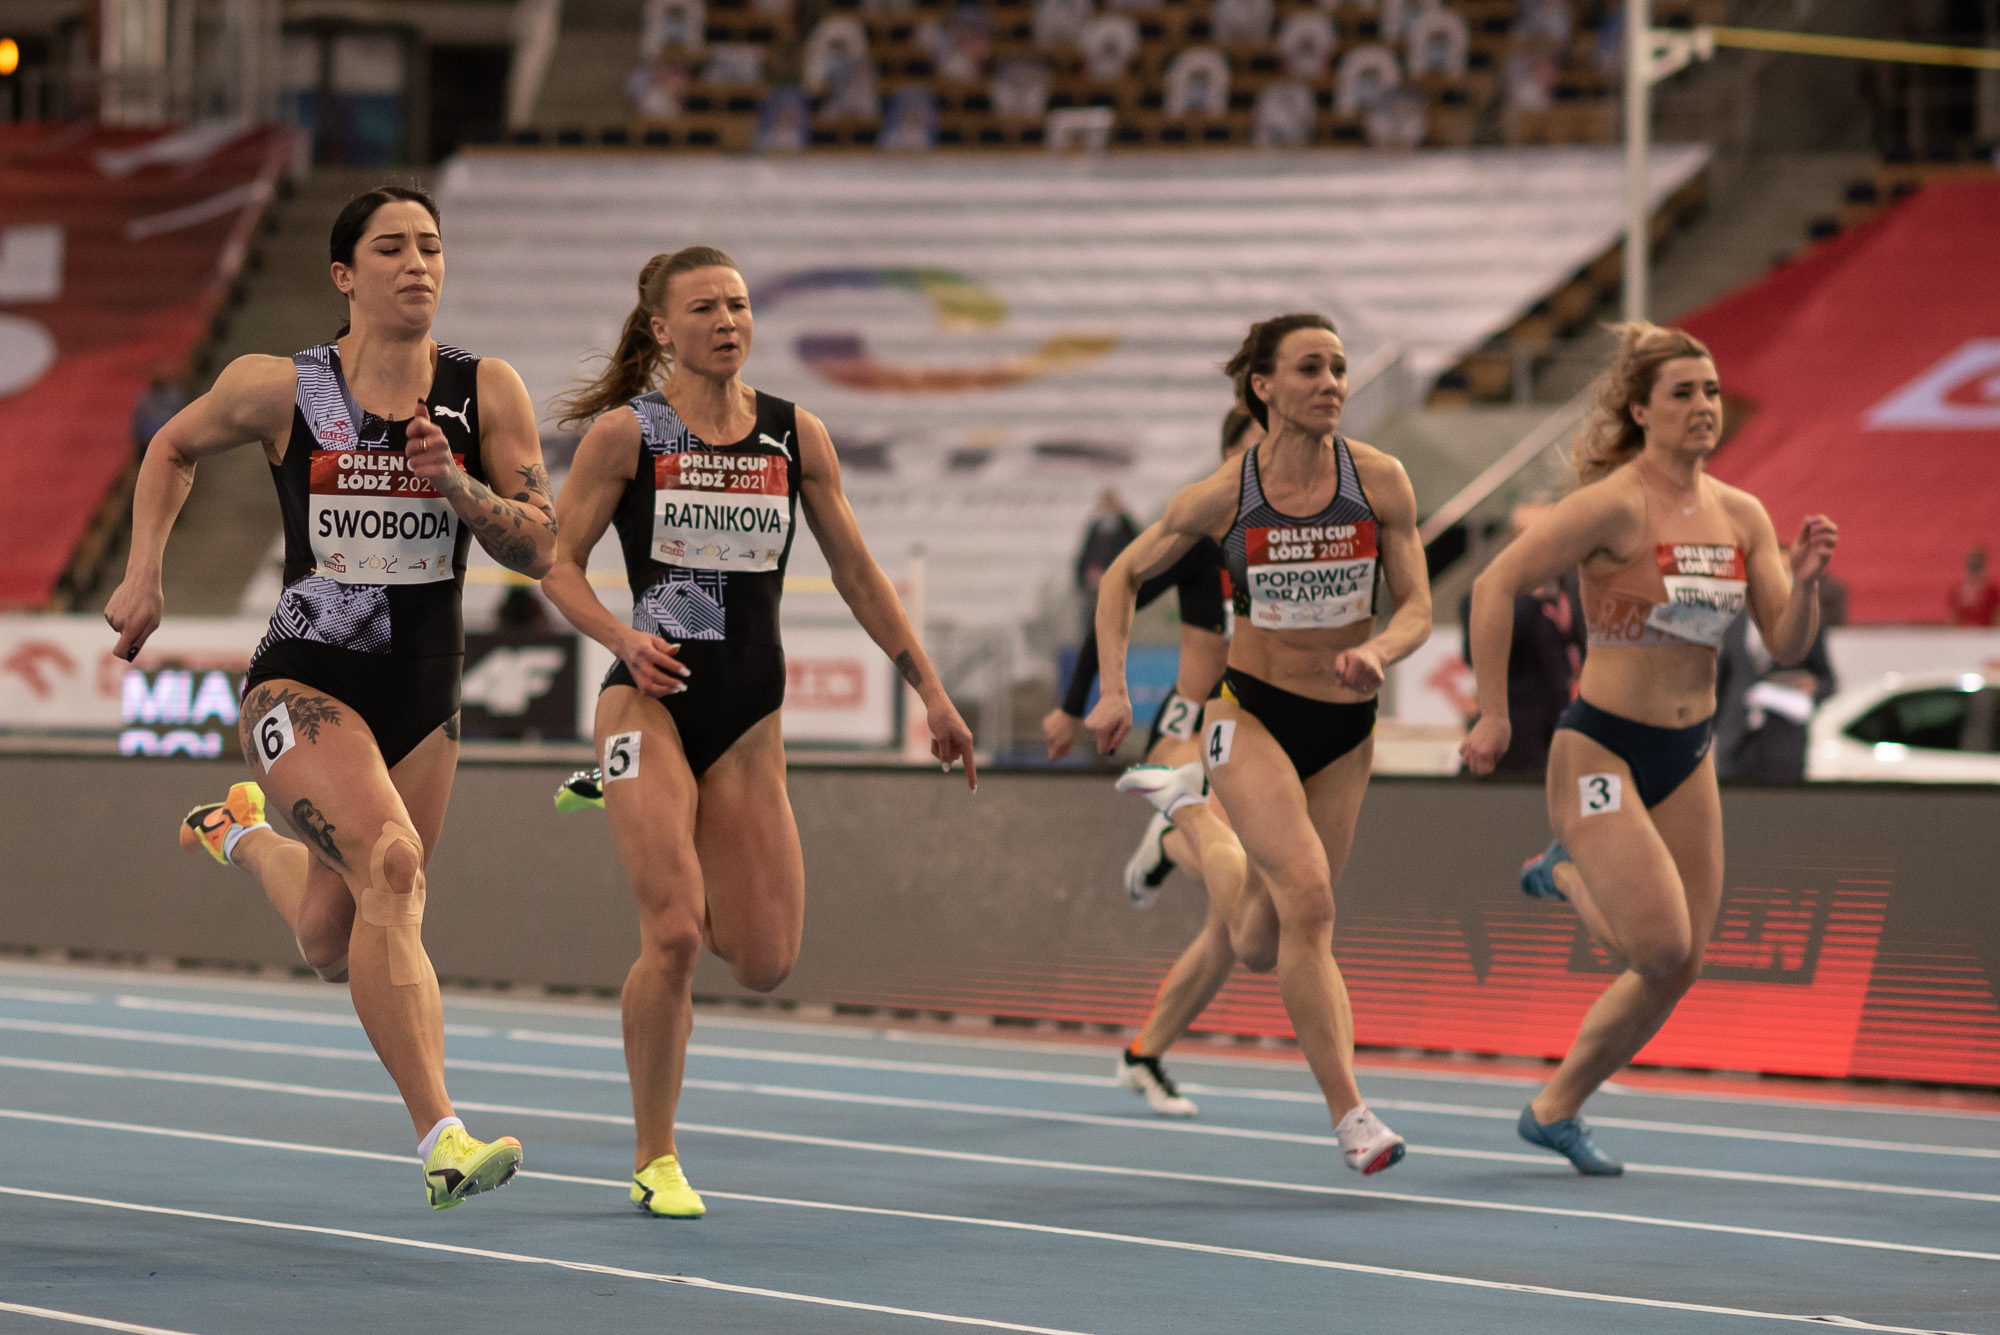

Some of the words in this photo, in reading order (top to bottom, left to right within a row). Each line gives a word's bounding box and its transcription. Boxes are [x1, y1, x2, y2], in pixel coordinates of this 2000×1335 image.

[338, 453, 403, 471] ORLEN
[678, 454, 735, 471] ORLEN
[736, 457, 768, 471] CUP
[337, 470, 391, 491] ŁÓDŹ
[398, 476, 437, 492] 202
[679, 468, 725, 488] ŁÓDŹ
[729, 474, 766, 489] 2021
[318, 508, 450, 540] SWOBODA
[663, 502, 781, 533] RATNIKOVA
[1267, 528, 1324, 544] ORLEN
[1324, 524, 1357, 540] CUP
[1268, 541, 1316, 560] ŁÓDŹ
[1319, 541, 1354, 558] 2021
[1255, 563, 1370, 587] POPOWICZ
[1166, 702, 1188, 733] 2
[262, 717, 284, 760] 6
[1210, 725, 1223, 762] 4
[608, 737, 631, 777] 5
[1589, 777, 1610, 810] 3
